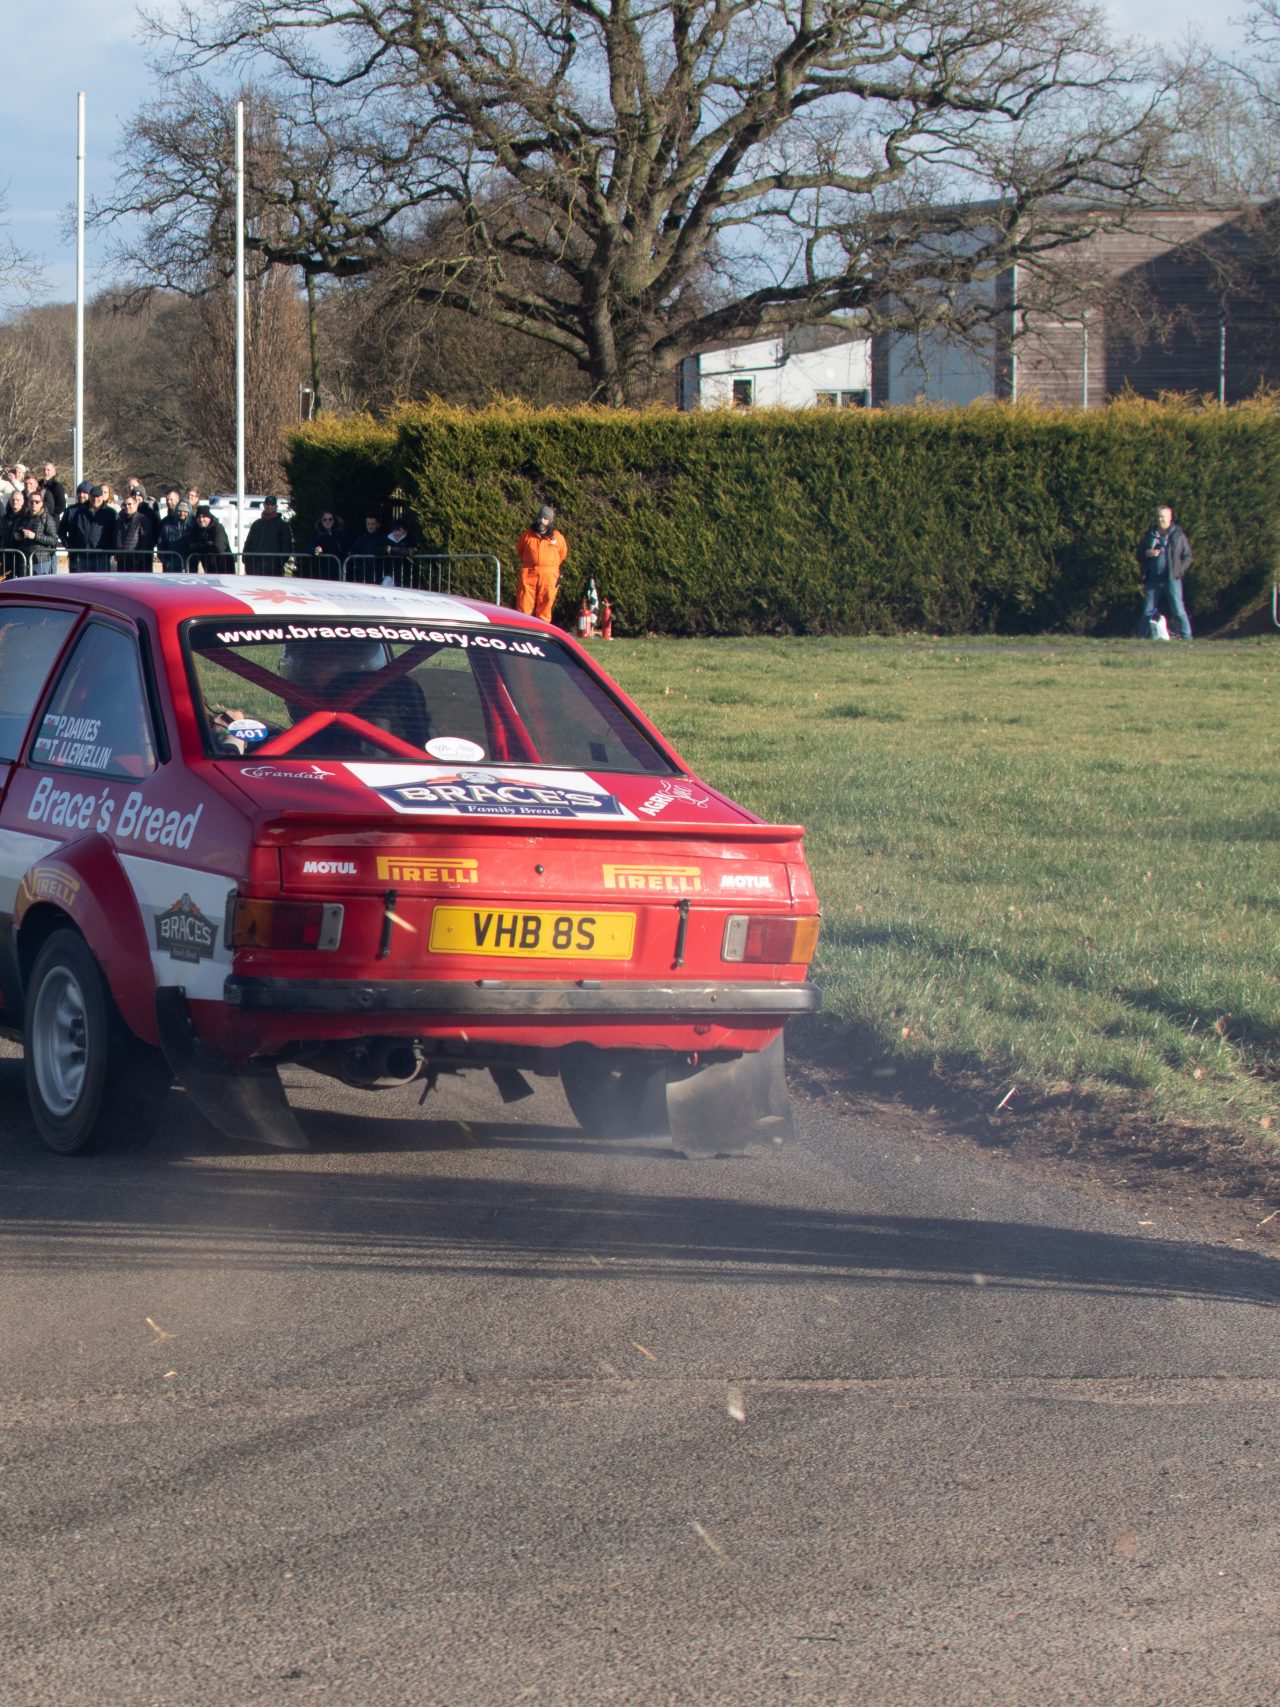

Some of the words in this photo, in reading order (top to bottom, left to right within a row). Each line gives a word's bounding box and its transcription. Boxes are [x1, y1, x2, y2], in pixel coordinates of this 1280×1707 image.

[217, 625, 546, 658] www.bracesbakery.co.uk
[56, 716, 101, 742] P.DAVIES
[235, 728, 263, 739] 401
[57, 741, 112, 769] LLEWELLIN
[396, 784, 602, 807] BRACE'S
[27, 776, 115, 834] Brace's
[116, 791, 204, 850] Bread
[468, 804, 516, 816] Family
[519, 806, 562, 816] Bread
[303, 861, 357, 875] MOTUL
[376, 856, 479, 883] PIRELLI
[602, 864, 702, 891] PIRELLI
[720, 875, 772, 888] MOTUL
[32, 867, 80, 907] PIRELLI
[161, 915, 212, 946] BRACE'S
[473, 912, 542, 949] VHB
[552, 917, 596, 951] 8S
